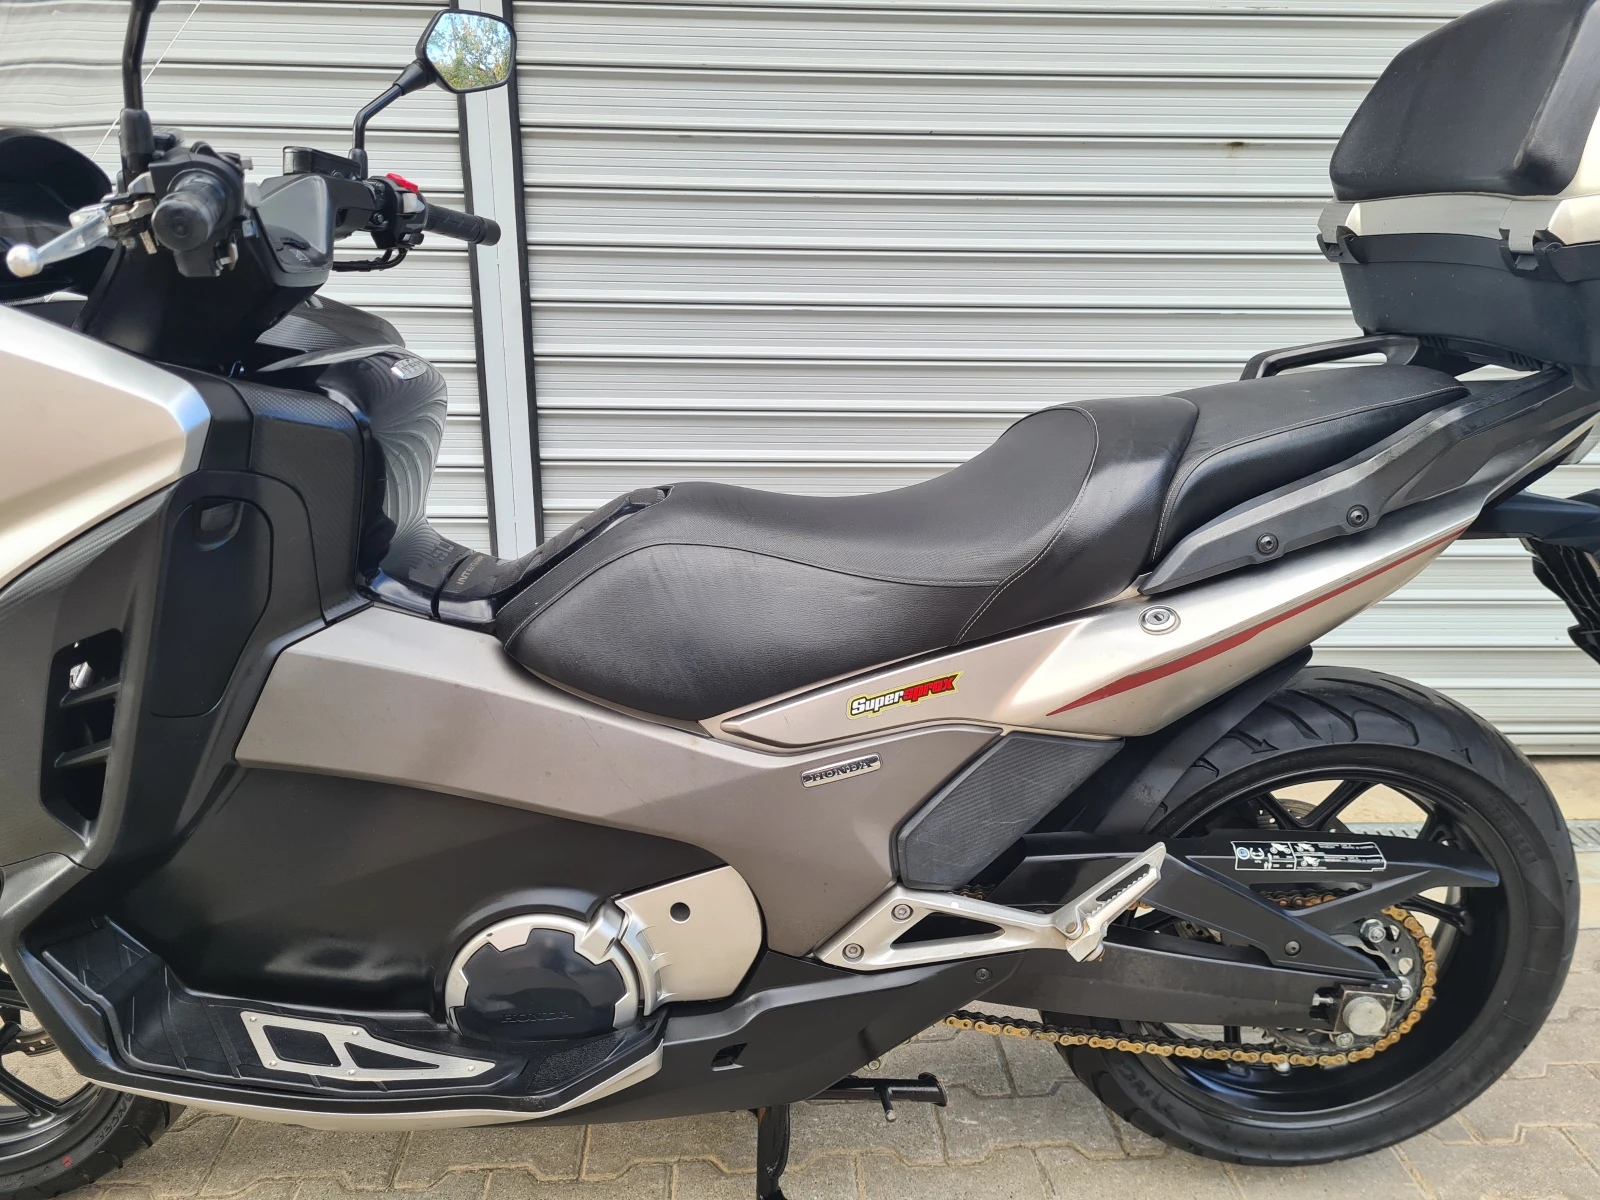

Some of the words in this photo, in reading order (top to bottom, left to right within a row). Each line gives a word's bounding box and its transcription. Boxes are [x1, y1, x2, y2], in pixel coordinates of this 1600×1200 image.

[851, 677, 956, 715] Supersprox
[811, 761, 874, 782] HONDA
[500, 1012, 575, 1023] HONDA
